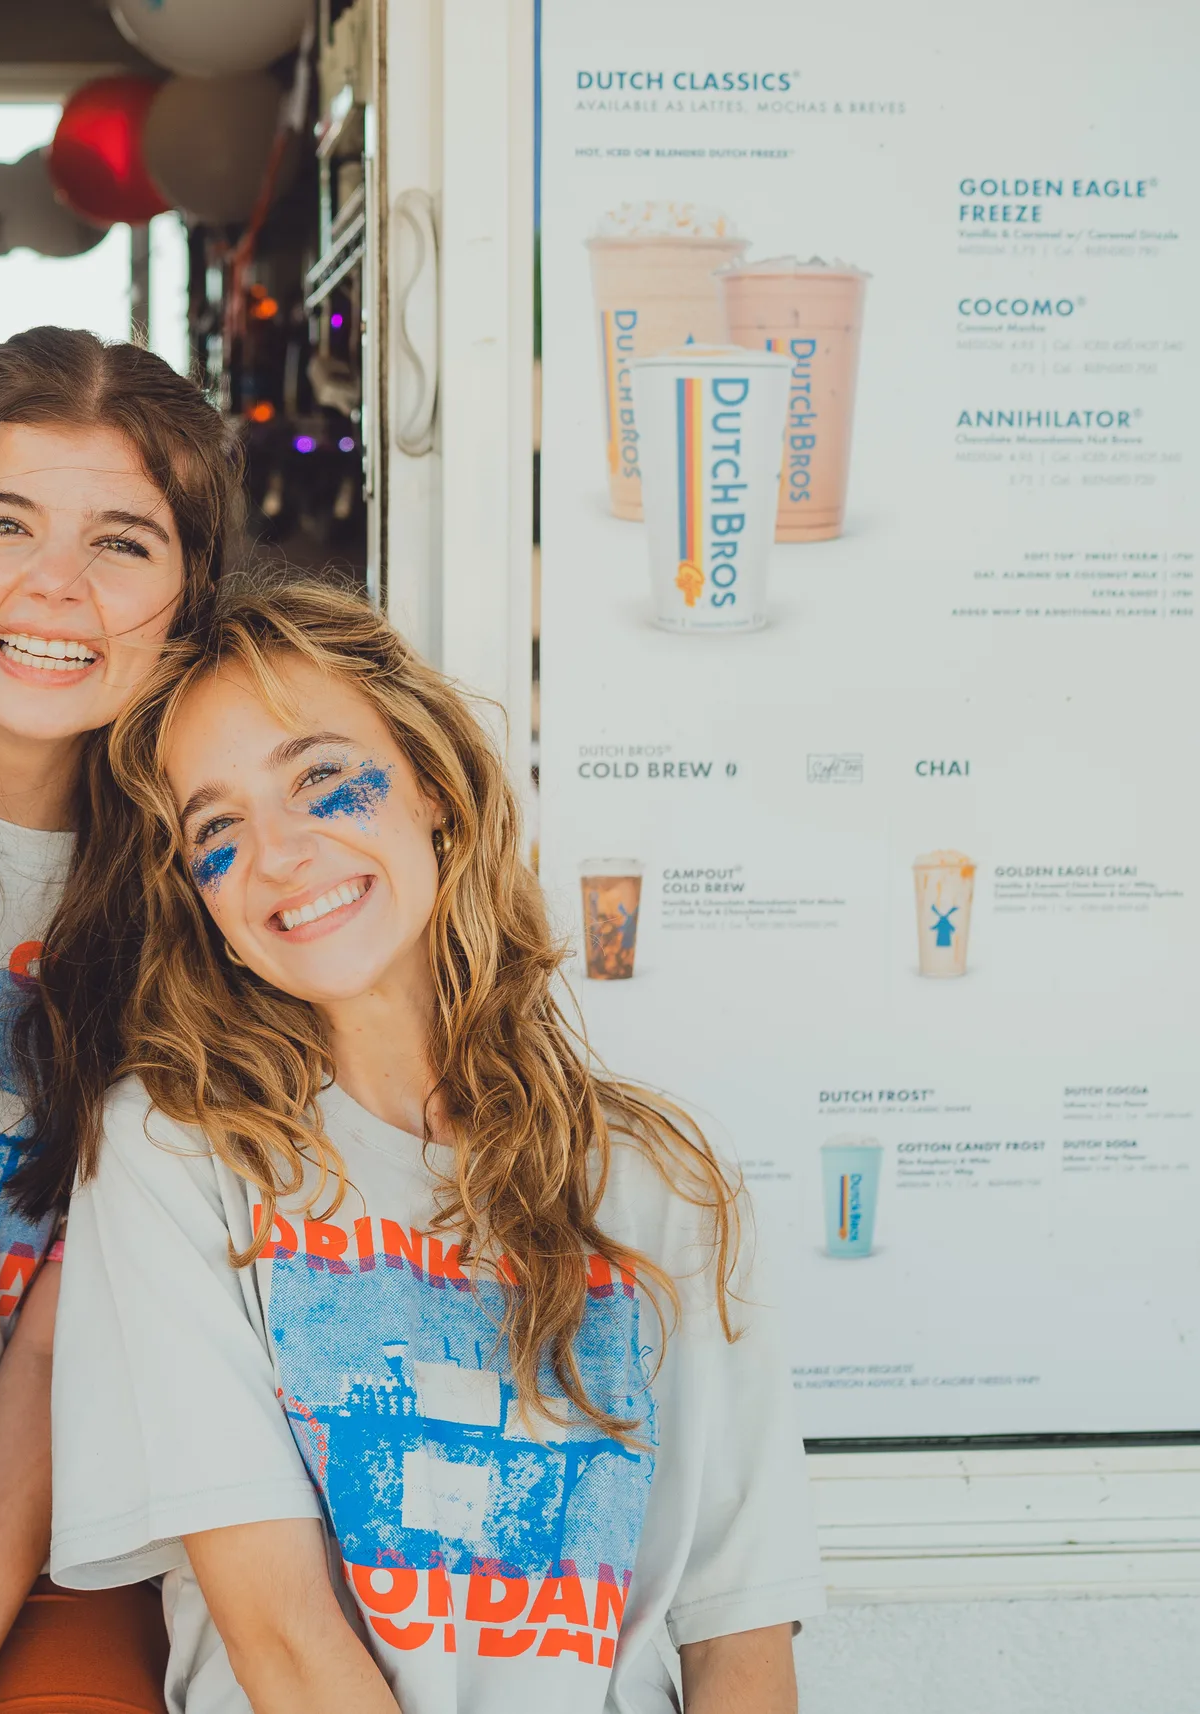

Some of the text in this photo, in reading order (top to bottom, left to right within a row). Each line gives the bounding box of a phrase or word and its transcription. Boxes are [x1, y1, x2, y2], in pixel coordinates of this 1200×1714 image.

[577, 71, 792, 90] DUTCH CLASSICS
[575, 100, 658, 113] AVAILABLE
[666, 100, 684, 113] AS
[758, 100, 827, 113] MOCHAS
[959, 178, 1148, 198] GOLDEN EAGLE
[959, 204, 1042, 223] FREEZE
[958, 299, 1074, 317] COCOMO
[956, 410, 1131, 428] ANNIHILATOR
[710, 513, 746, 608] BROS
[579, 745, 625, 757] DUTCH
[578, 762, 713, 779] COLD BREW
[916, 760, 971, 777] CHAI
[663, 869, 734, 880] CAMPOUT
[663, 883, 745, 893] COLD BREW
[819, 1089, 929, 1103] DUTCH FROST
[253, 1203, 476, 1292] DRINK
